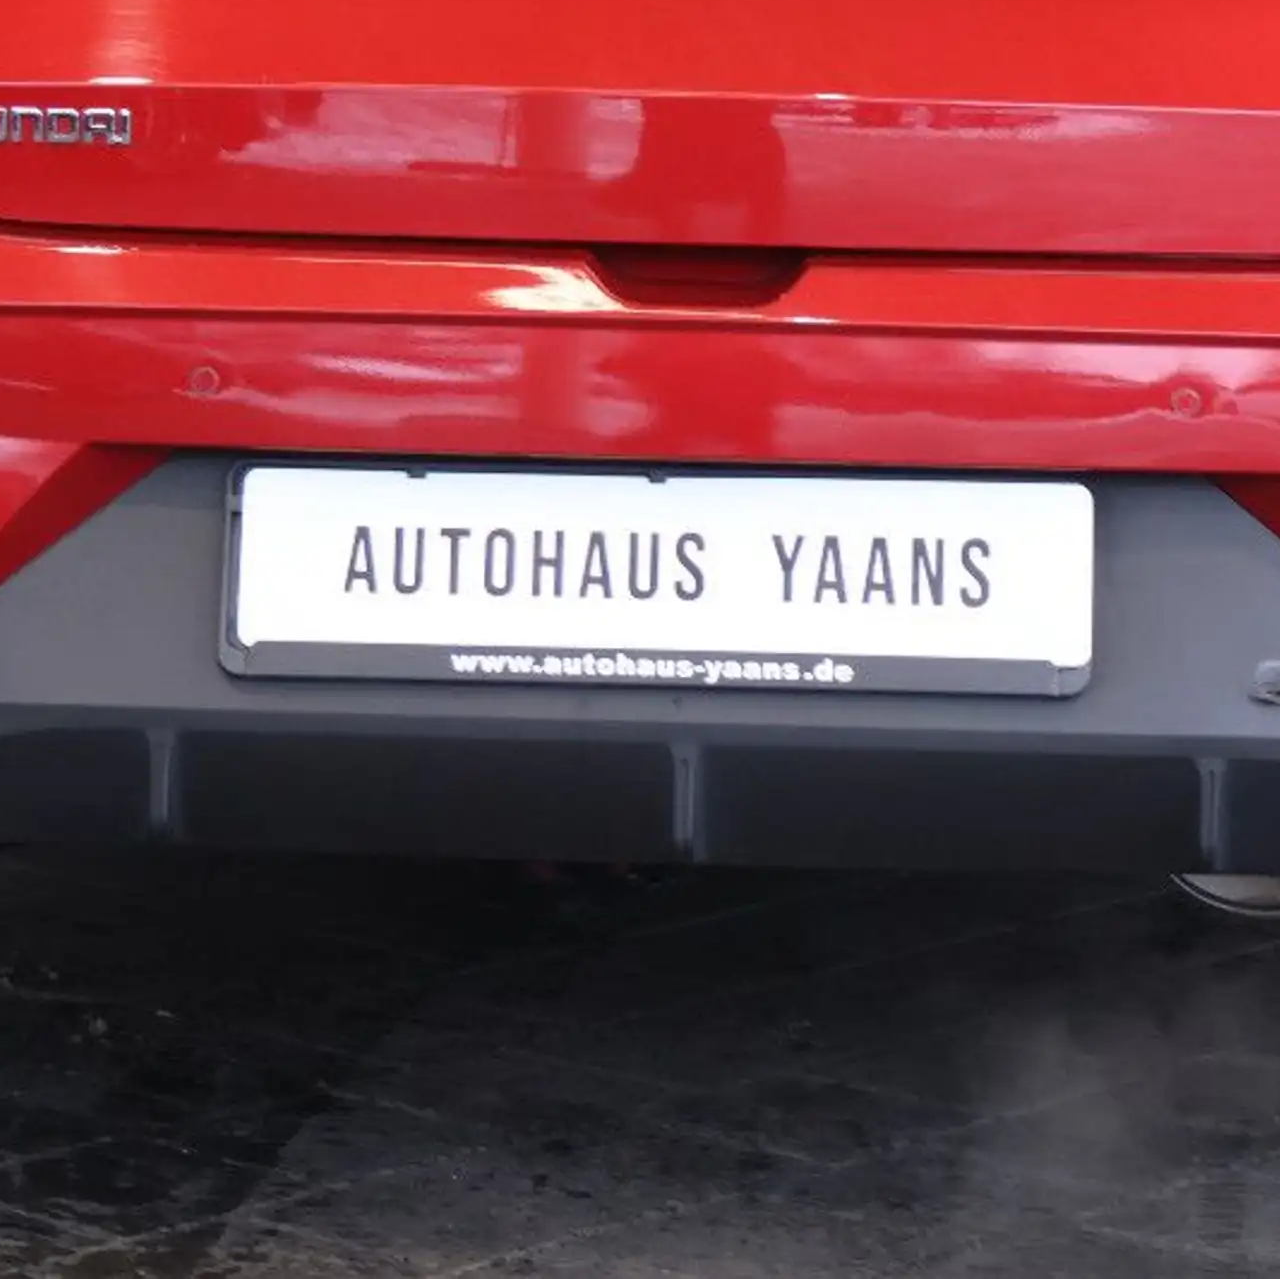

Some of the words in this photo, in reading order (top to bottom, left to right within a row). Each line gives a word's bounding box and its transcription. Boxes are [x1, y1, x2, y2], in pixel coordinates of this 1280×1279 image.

[344, 525, 708, 601] AUTOHAUS
[771, 534, 992, 608] YAANS
[450, 649, 855, 685] www.autohaus-yaans.de
